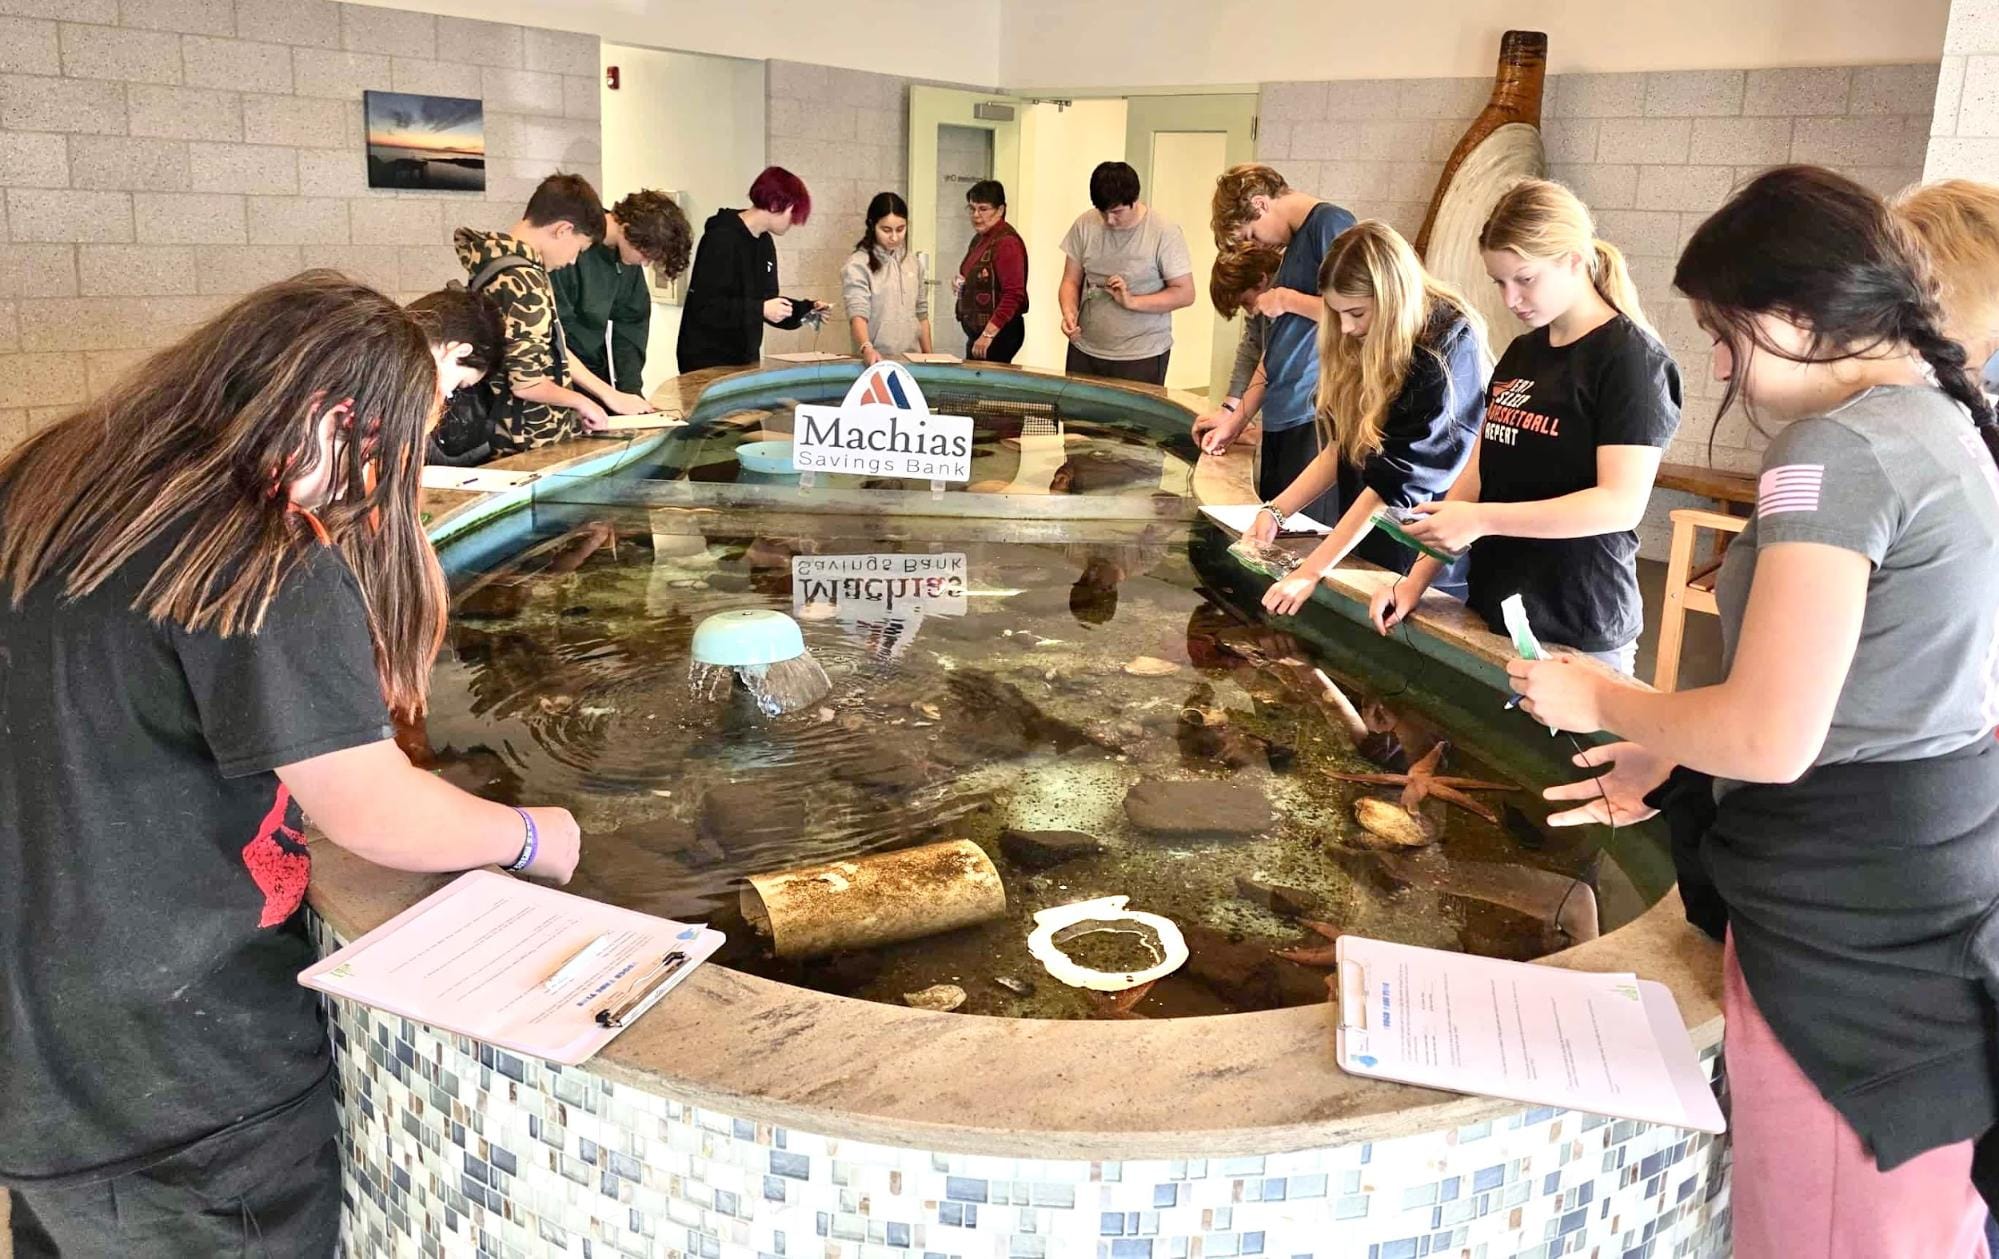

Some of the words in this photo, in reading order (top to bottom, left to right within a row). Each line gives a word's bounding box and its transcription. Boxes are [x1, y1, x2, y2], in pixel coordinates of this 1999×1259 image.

[801, 415, 967, 457] Machias
[799, 451, 895, 474] Savings
[906, 459, 966, 477] Bank
